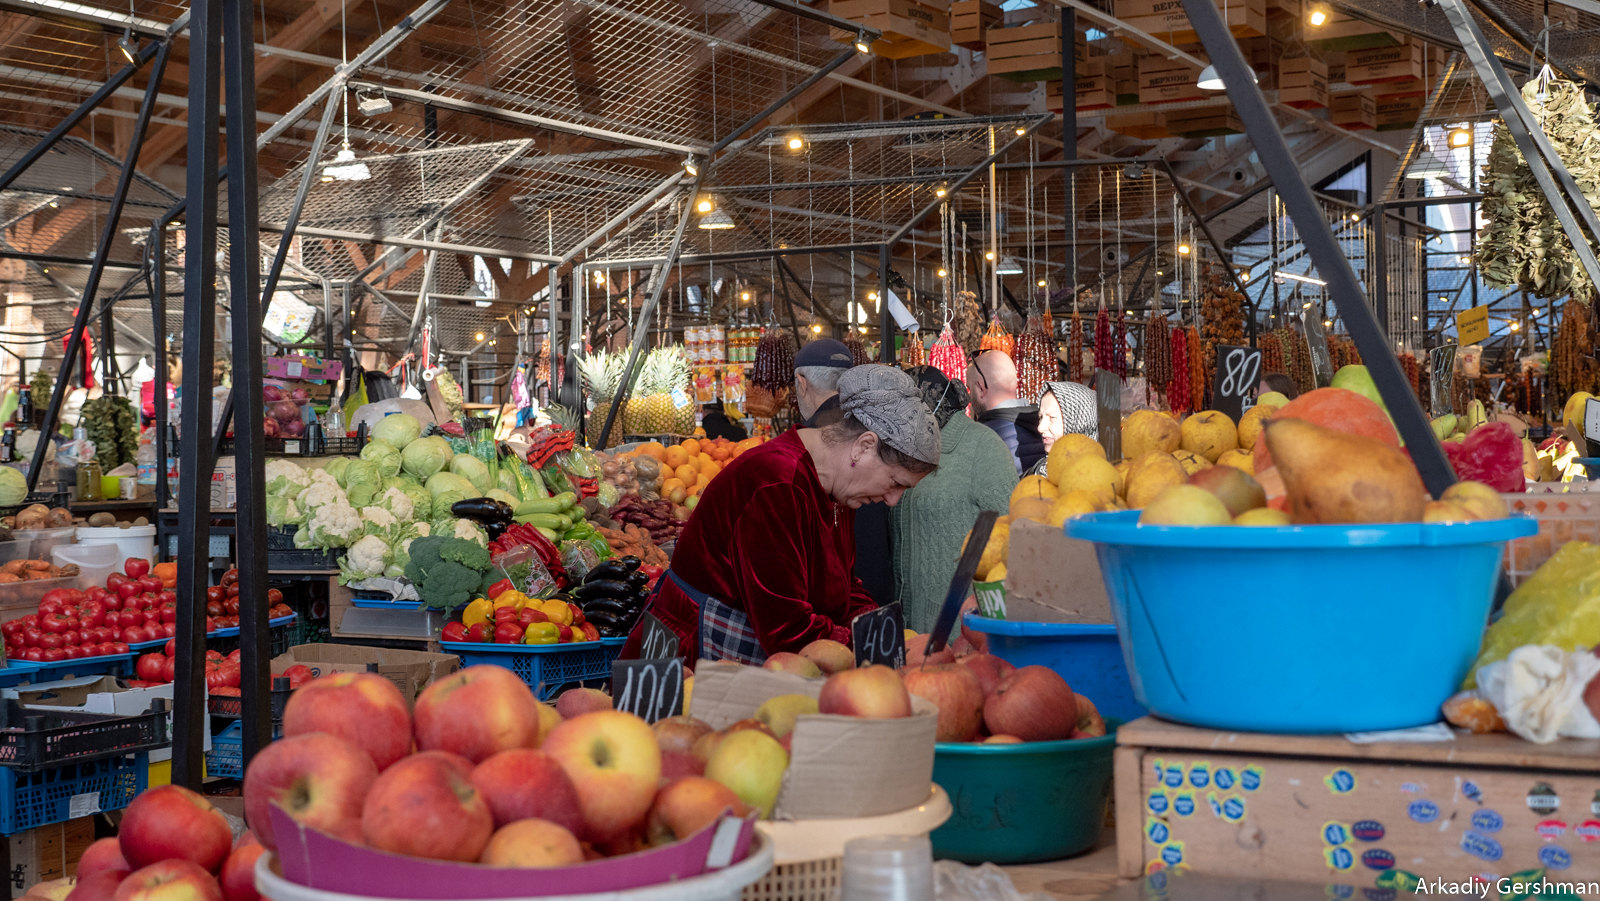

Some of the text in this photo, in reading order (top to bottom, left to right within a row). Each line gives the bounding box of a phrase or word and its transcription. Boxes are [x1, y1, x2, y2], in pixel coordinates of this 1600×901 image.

[1221, 348, 1261, 397] 80
[863, 615, 897, 659] 40
[617, 658, 682, 723] 100
